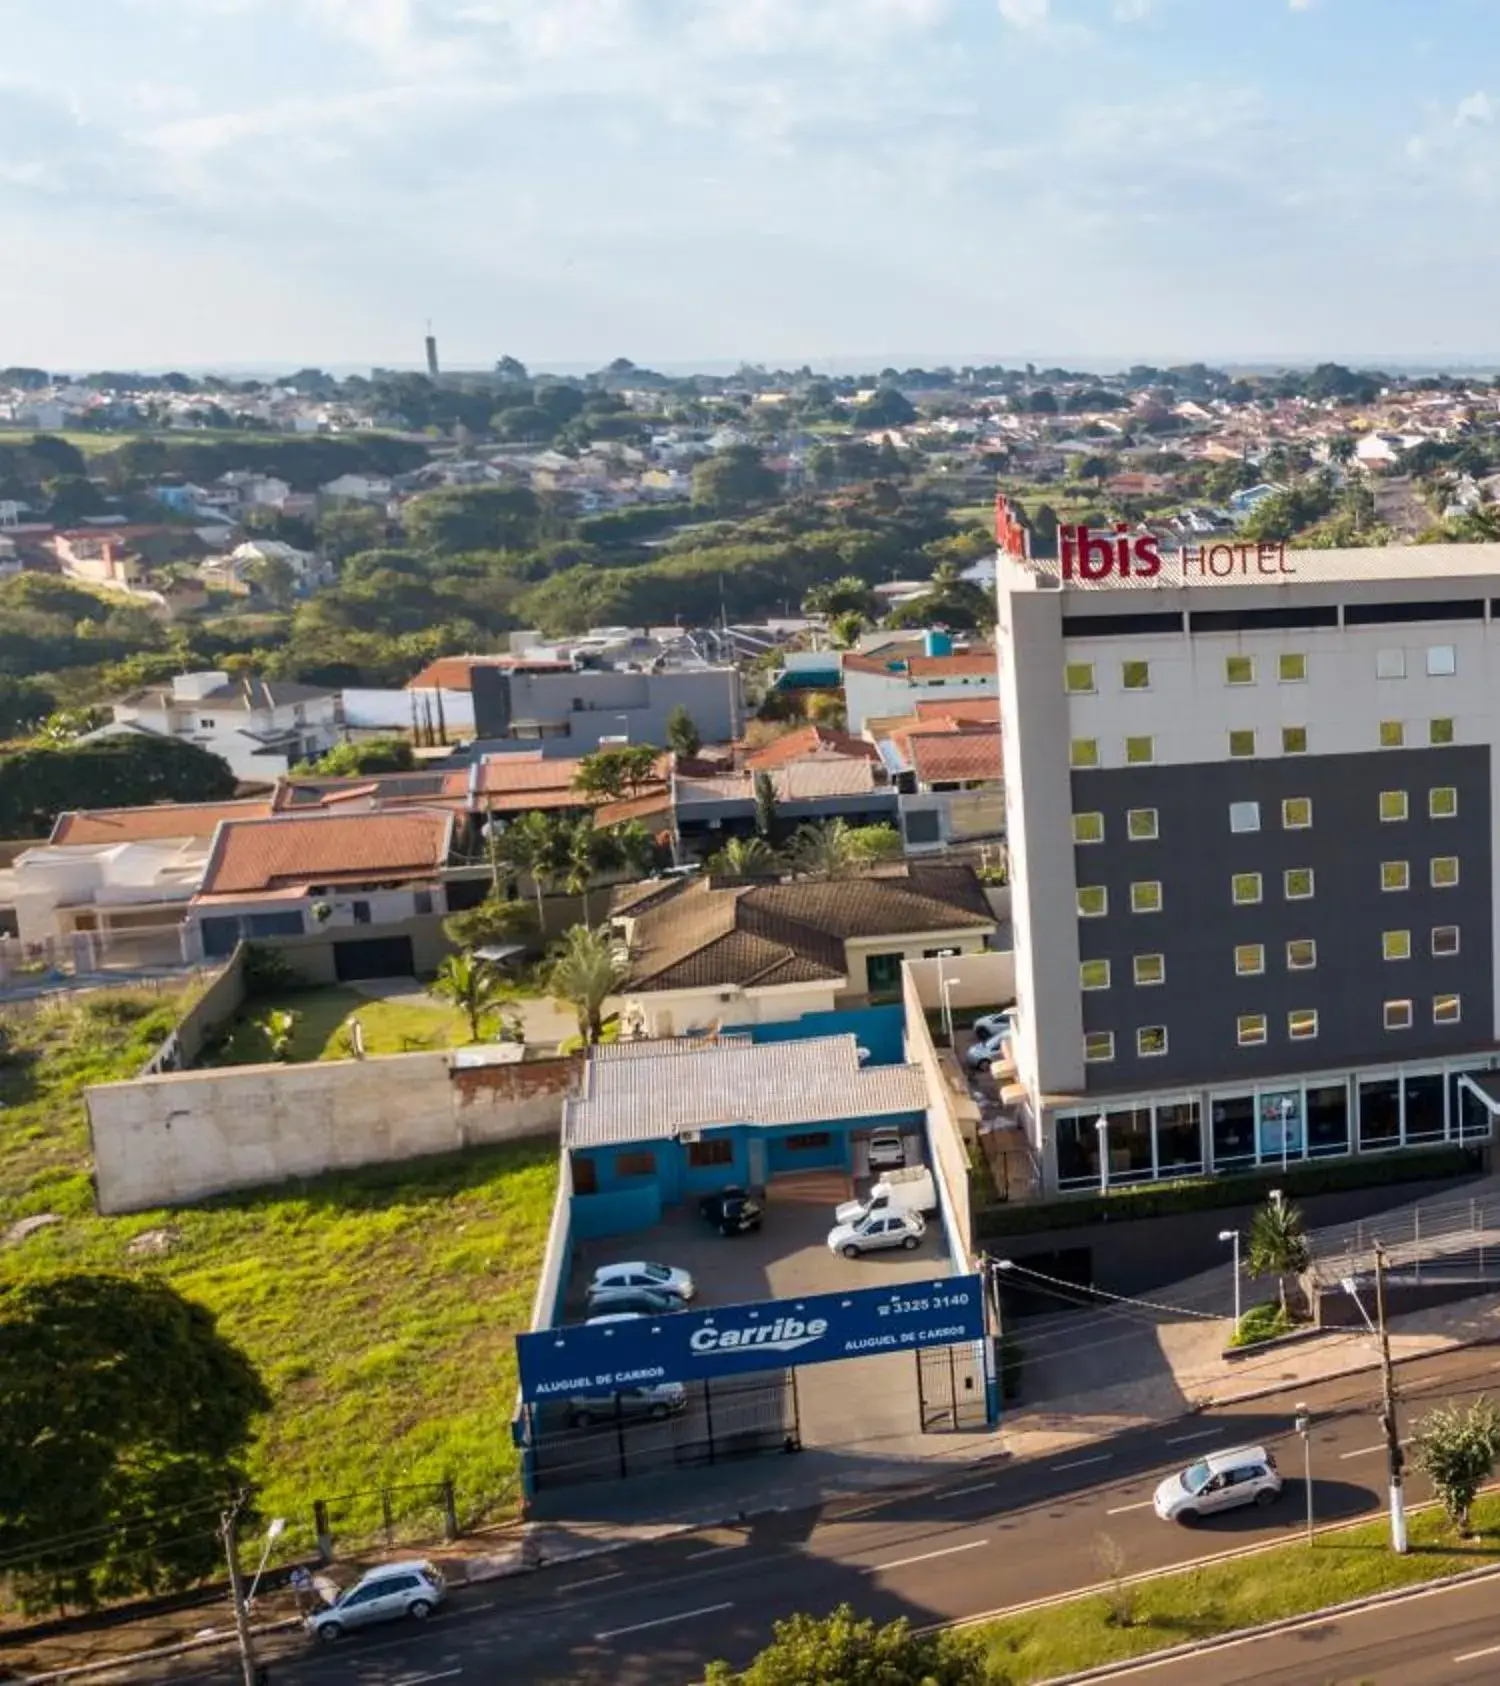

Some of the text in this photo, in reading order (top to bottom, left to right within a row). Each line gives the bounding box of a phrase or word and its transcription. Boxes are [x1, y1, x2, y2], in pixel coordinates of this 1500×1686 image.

[1060, 523, 1297, 580] ibis HOTEL
[893, 1293, 969, 1314] 3325 3140
[689, 1317, 828, 1350] Carribe
[845, 1325, 966, 1351] ALUGUEL DE CARROS
[536, 1366, 665, 1393] ALUGUEL DE CARROS
